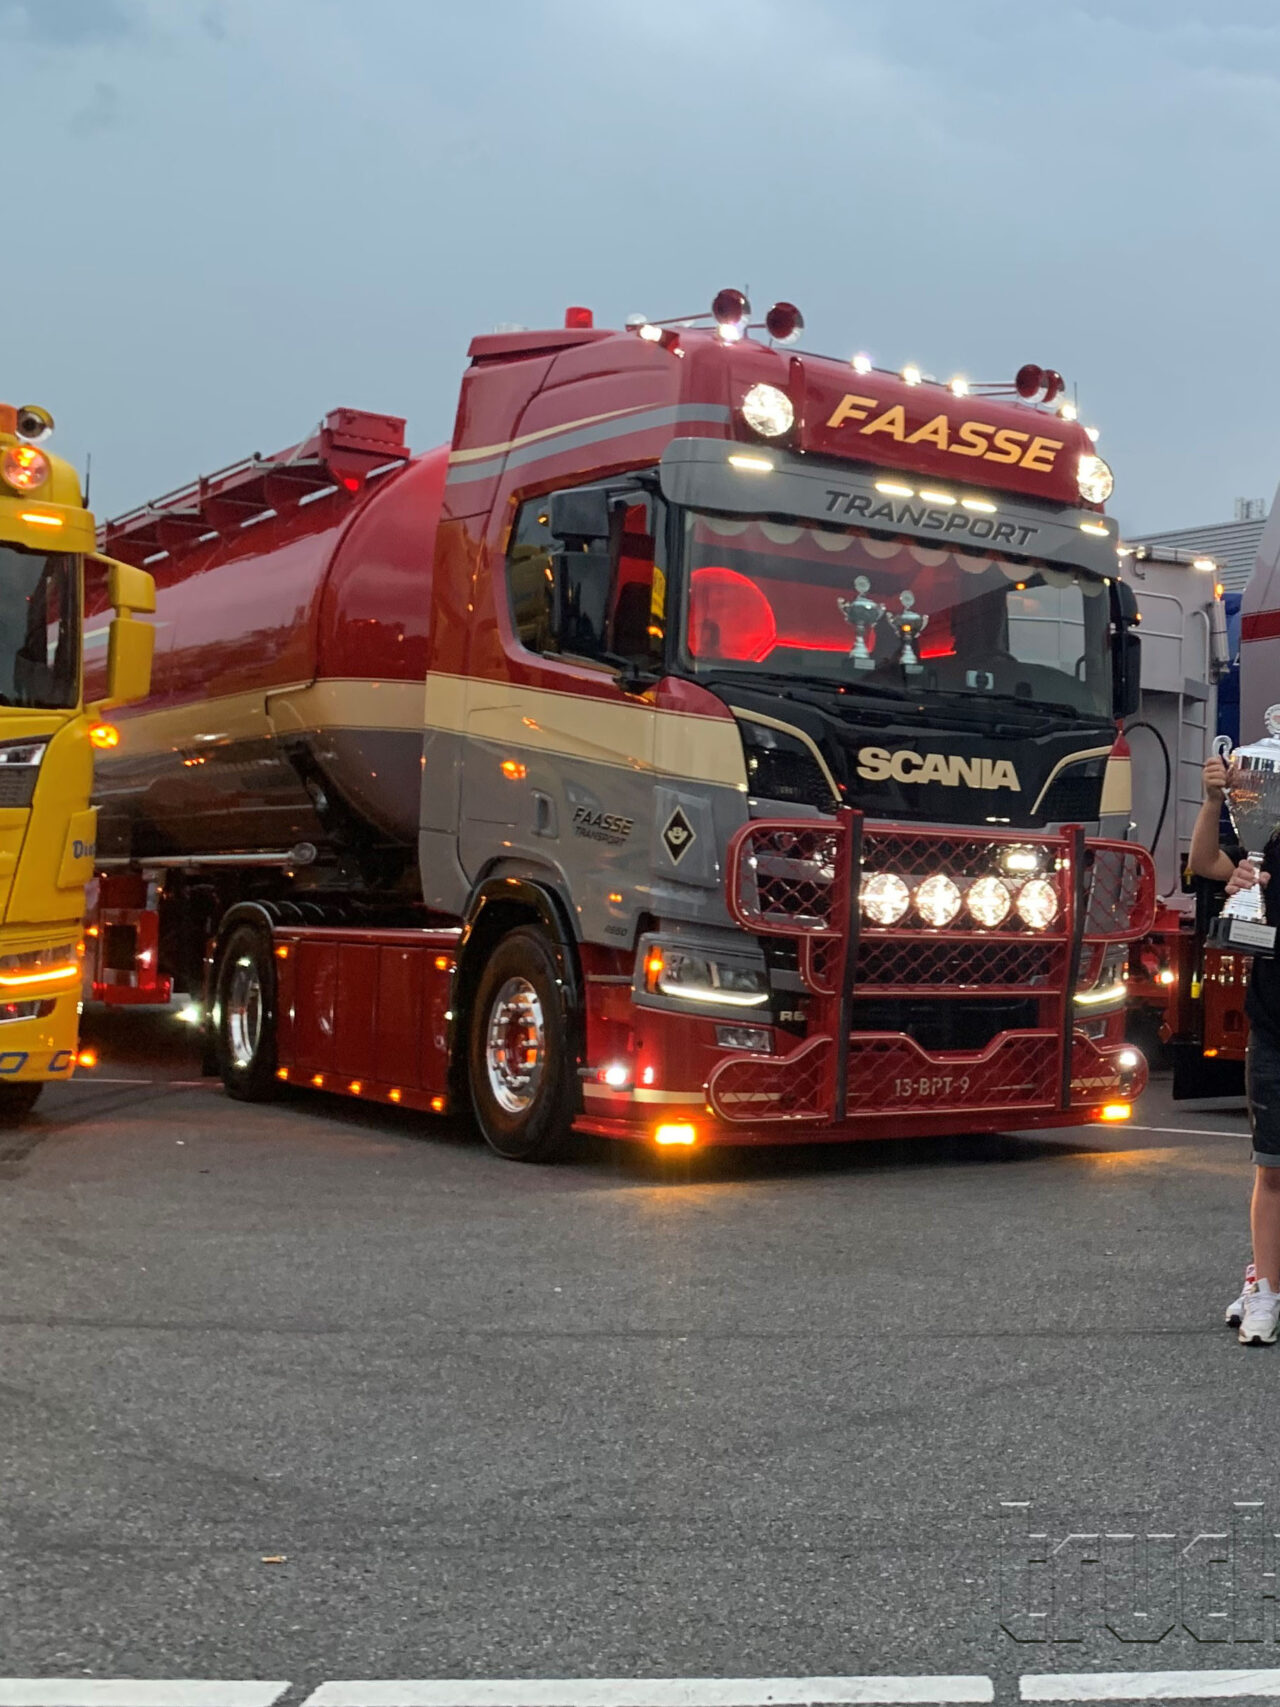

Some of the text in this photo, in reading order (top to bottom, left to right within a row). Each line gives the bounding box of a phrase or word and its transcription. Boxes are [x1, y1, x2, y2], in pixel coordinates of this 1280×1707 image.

[826, 394, 1064, 473] FAASSE
[825, 489, 1039, 546] TRANSPORT
[856, 747, 1022, 792] SCANIA
[573, 805, 635, 836] FAASSE
[575, 826, 627, 847] TRANSPORT
[895, 1076, 970, 1097] 13-BPT-9
